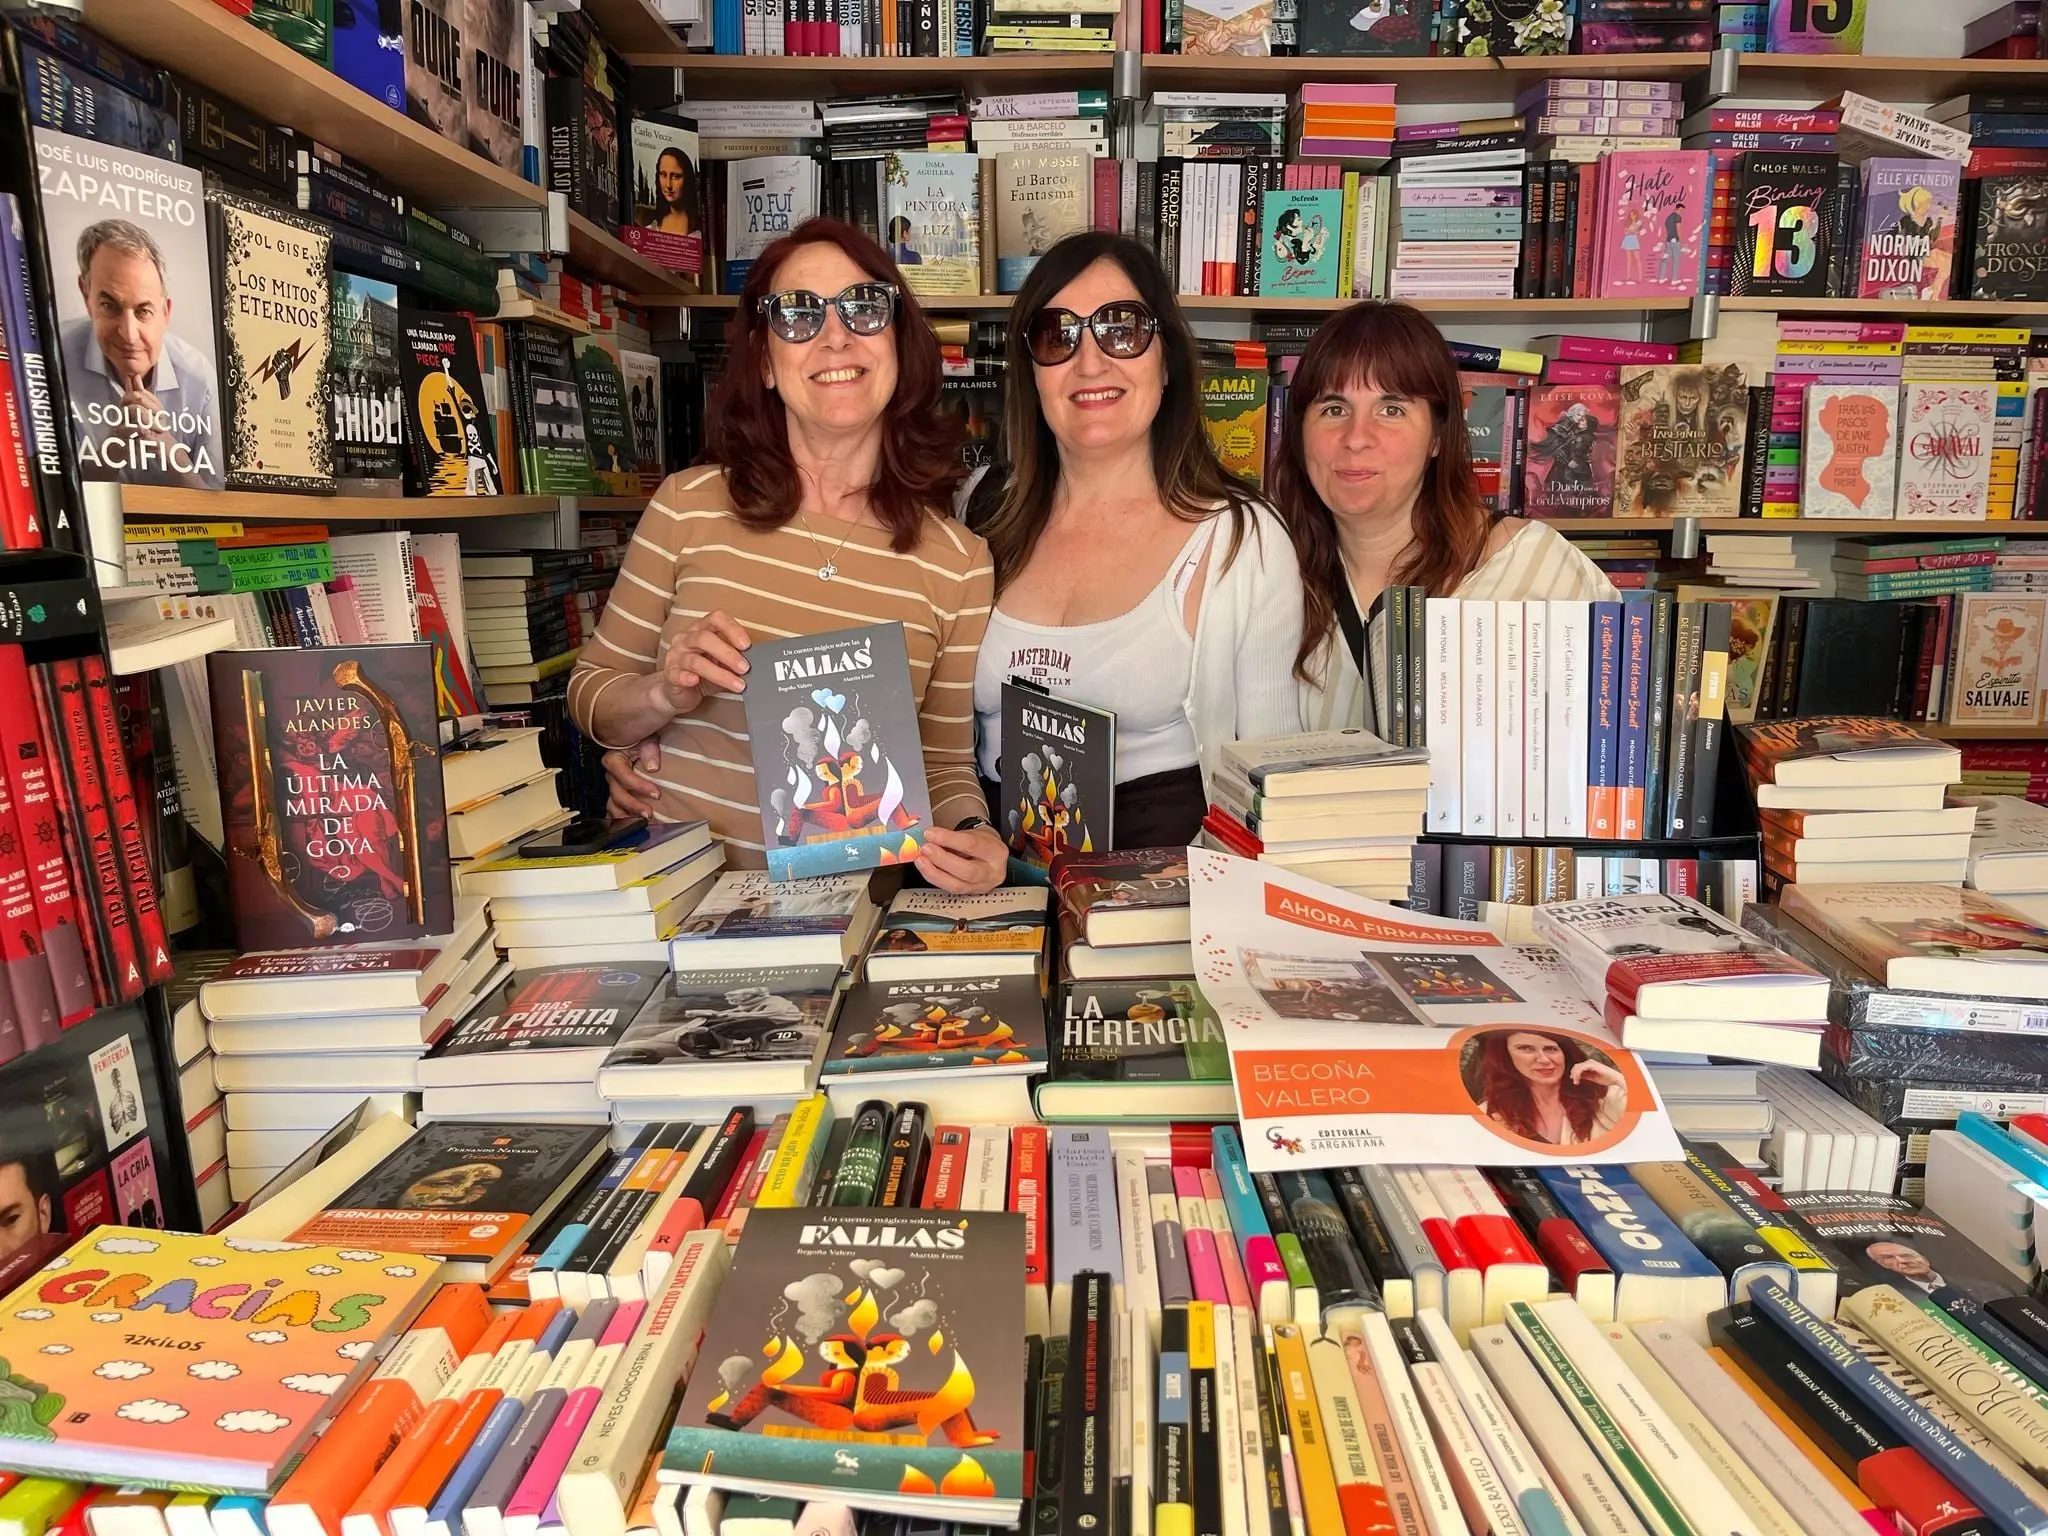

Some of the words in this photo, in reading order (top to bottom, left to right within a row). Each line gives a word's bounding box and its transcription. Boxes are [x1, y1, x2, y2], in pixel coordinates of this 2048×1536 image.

[986, 104, 1020, 116] LARK
[1736, 113, 1762, 121] CHLOE
[1008, 123, 1024, 132] ELIA
[1734, 120, 1762, 128] WALSH
[1896, 113, 1930, 132] SALVAJE
[634, 126, 656, 138] Carlo
[657, 130, 673, 143] Vecce
[1896, 129, 1930, 148] SALVAJE
[1014, 142, 1030, 150] ELIA
[1732, 140, 1759, 148] WALSH
[36, 141, 73, 165] JOSÉ
[76, 152, 108, 173] LUIS
[112, 161, 193, 194] RODRÍGUEZ
[916, 168, 954, 176] AGUILERA
[1754, 164, 1787, 174] CHLOE
[1792, 164, 1826, 174] WALSH
[1016, 176, 1026, 186] El
[1030, 174, 1068, 186] Barco
[1246, 165, 1258, 206] DIOSAS
[1624, 167, 1674, 194] Hate
[1877, 174, 1902, 184] ELLE
[1906, 173, 1954, 186] KENNEDY
[40, 166, 194, 227] ZAPATERO
[928, 186, 944, 198] LA
[1010, 190, 1074, 201] Fantasma
[1168, 170, 1180, 228] HERODES
[1645, 187, 1687, 212] Mail
[1746, 186, 1826, 214] Binding
[746, 196, 763, 214] YO
[768, 194, 792, 212] FUI
[904, 200, 968, 212] PINTORA
[1161, 186, 1169, 224] GRANDE
[748, 216, 758, 232] A
[764, 213, 789, 232] EGB
[923, 224, 950, 236] LUZ
[247, 230, 271, 249] POL
[277, 240, 309, 260] GISE
[1750, 205, 1819, 278] 13
[1870, 235, 1930, 256] NORMA
[1867, 259, 1923, 282] DIXON
[238, 270, 265, 292] LOS
[273, 279, 316, 304] MITOS
[240, 295, 318, 328] ETERNOS
[407, 329, 419, 338] UNA
[420, 331, 442, 341] GALAXIA
[444, 334, 456, 342] POP
[412, 341, 438, 352] LLAMADA
[439, 344, 456, 354] ONE
[416, 354, 440, 366] PIECE
[585, 371, 616, 382] GABRIEL
[960, 380, 997, 389] ALANDES
[587, 383, 617, 394] GARCÍA
[1205, 393, 1254, 401] VALENCIANS
[1540, 393, 1573, 402] ELISE
[1579, 392, 1613, 401] KOVA
[589, 395, 619, 406] MÁRQUEZ
[1838, 404, 1860, 414] TRAS
[1861, 405, 1876, 414] LOS
[10, 391, 22, 437] ORWELL
[24, 352, 62, 475] FRANKENSTEIN
[88, 403, 211, 436] SOLUCIÓN
[1836, 417, 1868, 428] PASOS
[1653, 428, 1706, 439] LABERINTO
[1836, 430, 1849, 441] DE
[1850, 430, 1872, 441] JANE
[78, 433, 215, 475] ACÍFICA
[1641, 442, 1723, 459] BESTIARIO
[1756, 428, 1768, 474] DORADOS
[1836, 444, 1869, 454] AUSTEN
[15, 439, 29, 487] GEORGE
[1552, 480, 1584, 494] Duelo
[228, 553, 247, 564] BORJA
[1601, 614, 1613, 624] La
[1680, 618, 1688, 629] DE
[1508, 623, 1516, 652] Jessica
[1693, 625, 1700, 637] EL
[1602, 626, 1613, 658] editorial
[774, 648, 872, 681] FALLAS
[1008, 648, 1071, 672] AMSTERDAM
[1678, 632, 1688, 681] FLORENCIA
[1690, 638, 1700, 674] DESAFÍO
[1531, 648, 1540, 698] Hemingway
[1602, 659, 1612, 673] del
[1601, 674, 1611, 698] señor
[296, 698, 360, 716] JAVIER
[1966, 691, 2029, 707] SALVAJE
[285, 716, 371, 733] ALANDES
[1022, 708, 1086, 744] FALLAS
[319, 753, 348, 770] LA
[286, 772, 383, 794] ÚLTIMA
[286, 794, 388, 816] MIRADA
[324, 817, 353, 836] DE
[306, 838, 375, 858] GOYA
[1546, 901, 1624, 916] ROSA
[1280, 897, 1359, 932] AHORA
[1363, 922, 1488, 944] FIRMANDO
[888, 979, 1000, 996] FALLAS
[530, 1000, 572, 1012] TRAS
[1065, 996, 1103, 1020] LA
[458, 1018, 500, 1036] LA
[504, 1008, 618, 1028] PUERTA
[448, 1030, 510, 1047] FREIDA
[1064, 1018, 1224, 1046] HERENCIA
[1253, 1059, 1375, 1082] BEGOÑA
[1255, 1088, 1371, 1107] VALERO
[1318, 1128, 1372, 1138] EDITORIAL
[1311, 1138, 1385, 1149] SARGANTANA
[117, 1171, 130, 1188] LA
[324, 1210, 423, 1221] FERNANDO
[428, 1212, 510, 1222] NAVARRO
[822, 1216, 836, 1224] Un
[838, 1216, 872, 1224] cuento
[874, 1217, 906, 1226] mágico
[800, 1225, 965, 1250] FALLAS
[1816, 1222, 1878, 1236] después
[1880, 1222, 1896, 1232] de
[1914, 1225, 1946, 1236] vida
[798, 1248, 826, 1256] Begoña
[647, 1287, 681, 1337] PRETÉRITO
[671, 1243, 704, 1291] IMPERFECTO
[1768, 1286, 1806, 1323] Huerta
[1806, 1322, 1860, 1368] Máximo
[1908, 1335, 2020, 1416] BOVARY
[600, 1400, 623, 1438] NIEVES
[616, 1342, 654, 1404] CONCOSTRINA
